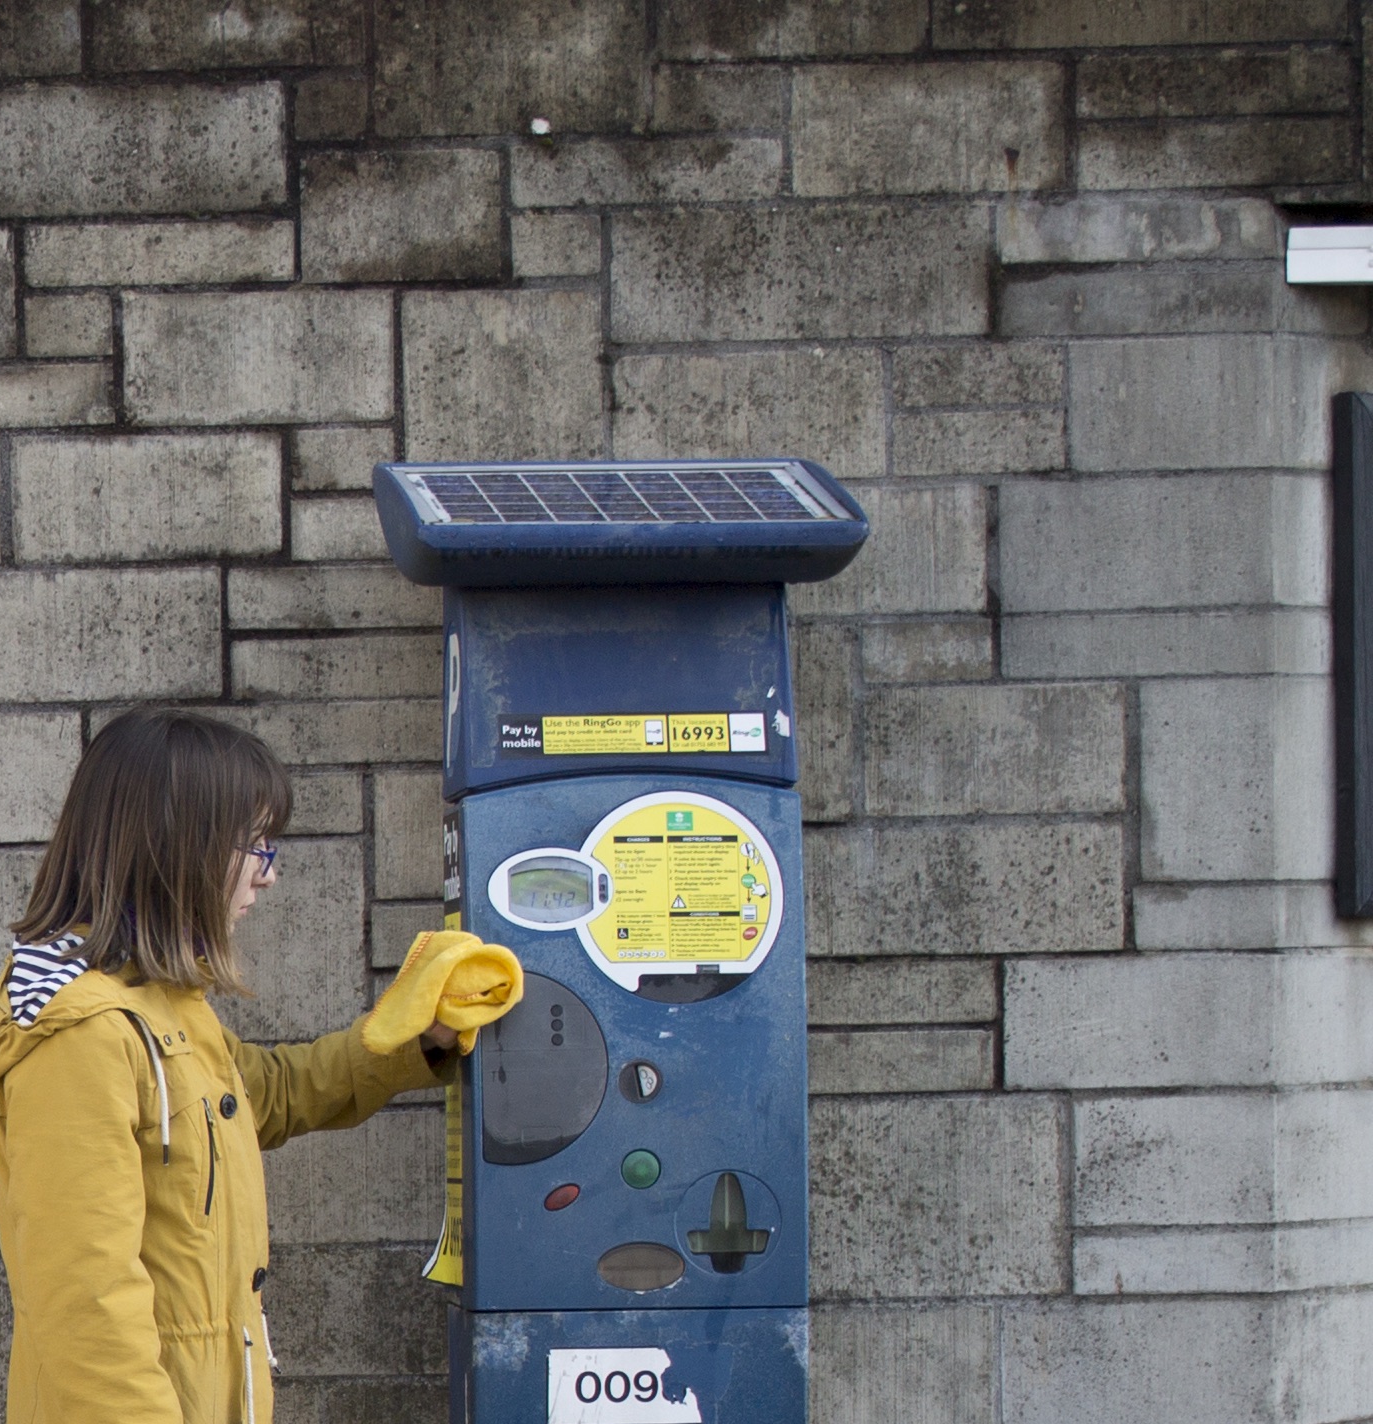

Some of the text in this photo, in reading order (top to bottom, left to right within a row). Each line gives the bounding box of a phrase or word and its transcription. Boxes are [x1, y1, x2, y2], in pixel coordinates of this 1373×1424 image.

[583, 718, 622, 728] RingGo
[502, 724, 538, 737] Pay by
[672, 726, 725, 741] 16993
[502, 738, 541, 748] mobile
[575, 1370, 687, 1404] 009
